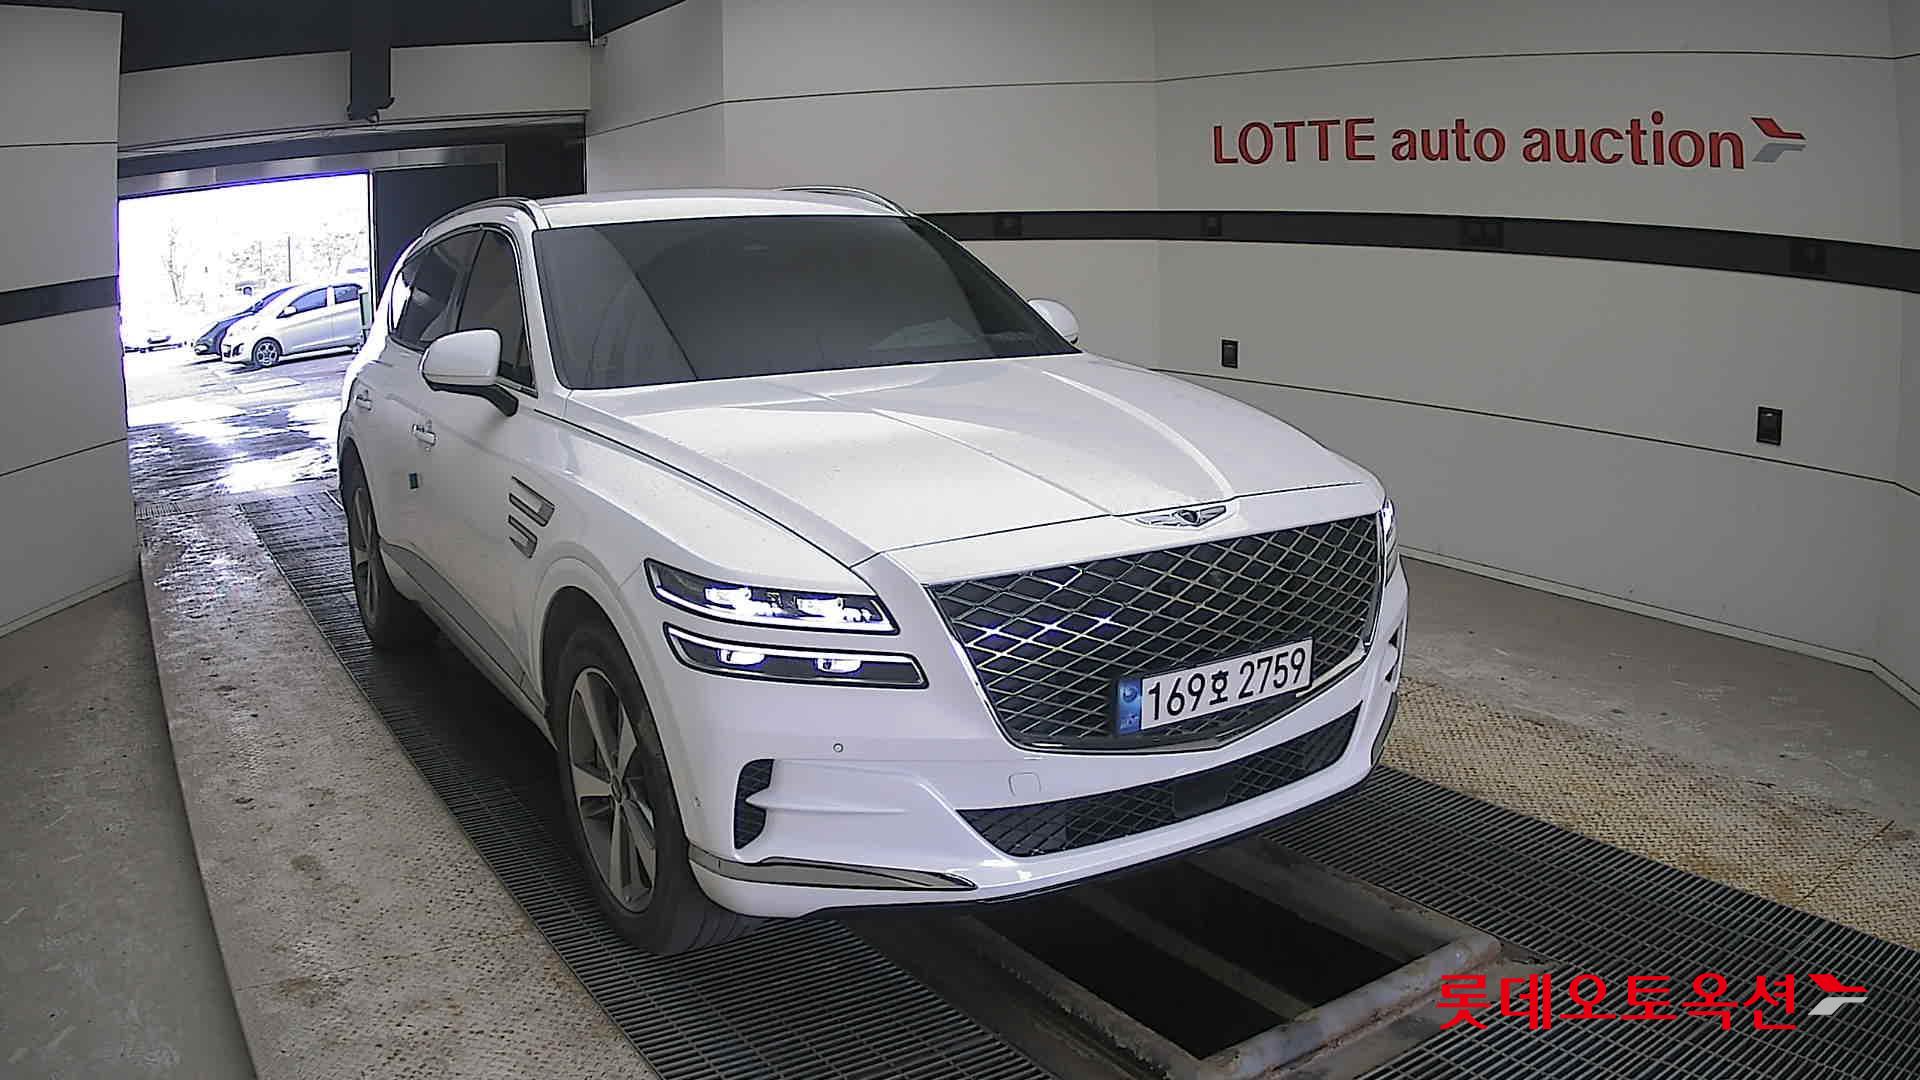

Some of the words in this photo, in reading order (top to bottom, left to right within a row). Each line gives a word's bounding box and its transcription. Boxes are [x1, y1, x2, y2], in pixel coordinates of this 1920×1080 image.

[1212, 117, 1376, 164] LOTTE
[1391, 118, 1506, 163] auto
[1522, 111, 1745, 169] auction
[1148, 670, 1229, 721] 169호
[1238, 647, 1306, 700] 2759
